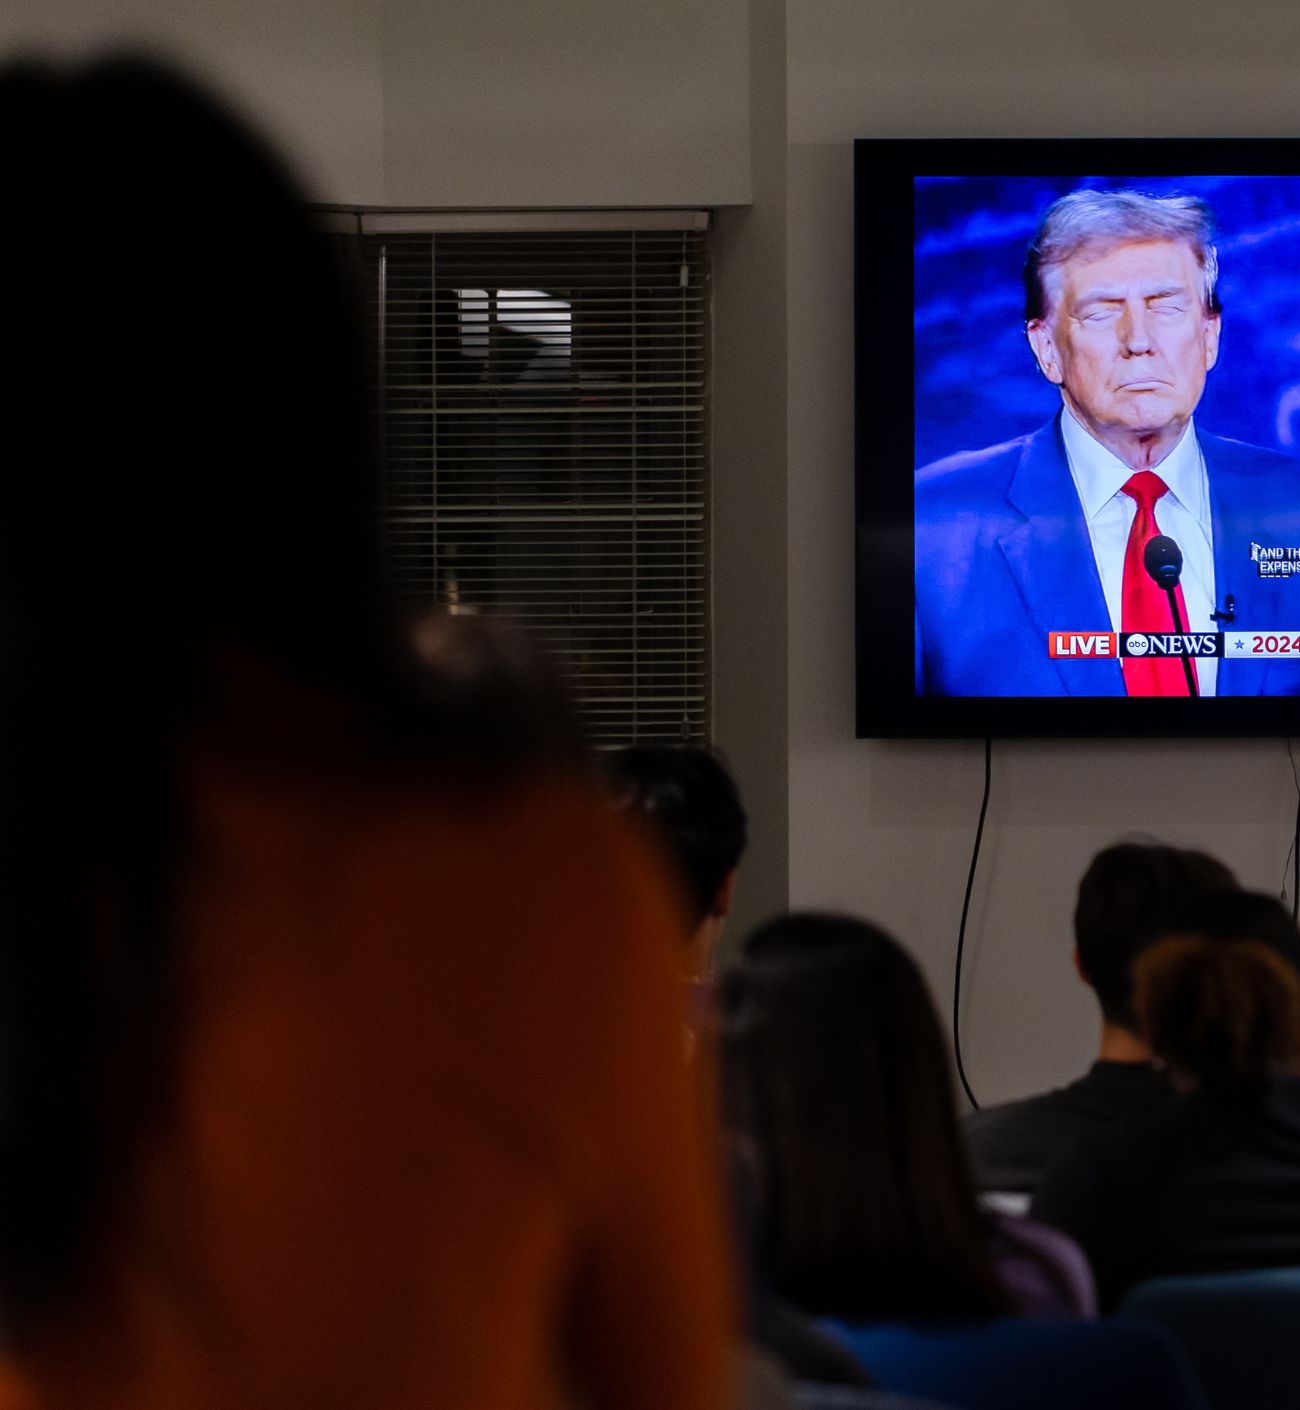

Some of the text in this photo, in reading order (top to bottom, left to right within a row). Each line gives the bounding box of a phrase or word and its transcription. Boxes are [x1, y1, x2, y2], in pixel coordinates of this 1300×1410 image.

[1260, 547, 1284, 559] AND
[1056, 635, 1110, 655] LIVE
[1128, 640, 1147, 648] abc
[1148, 634, 1216, 655] NEWS
